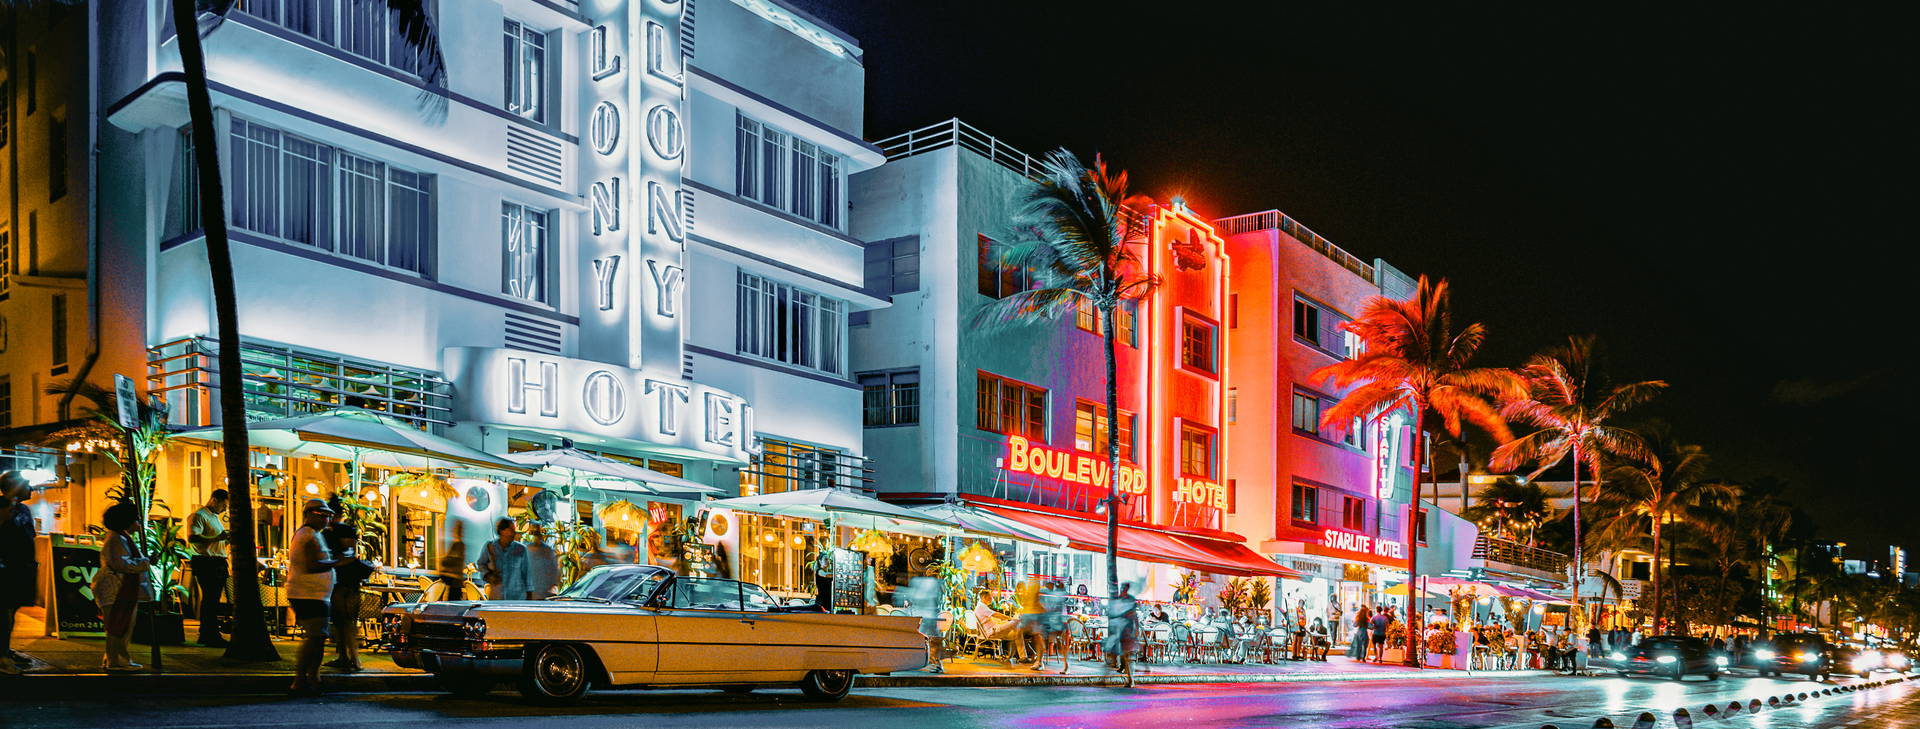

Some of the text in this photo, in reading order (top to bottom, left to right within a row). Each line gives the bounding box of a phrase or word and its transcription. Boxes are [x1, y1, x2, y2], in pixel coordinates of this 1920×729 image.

[508, 357, 761, 456] HOTEL
[1379, 415, 1391, 498] STARLITE
[1177, 477, 1228, 510] HOTEL
[1324, 529, 1403, 559] STARLITE HOTEL
[61, 621, 86, 629] Open
